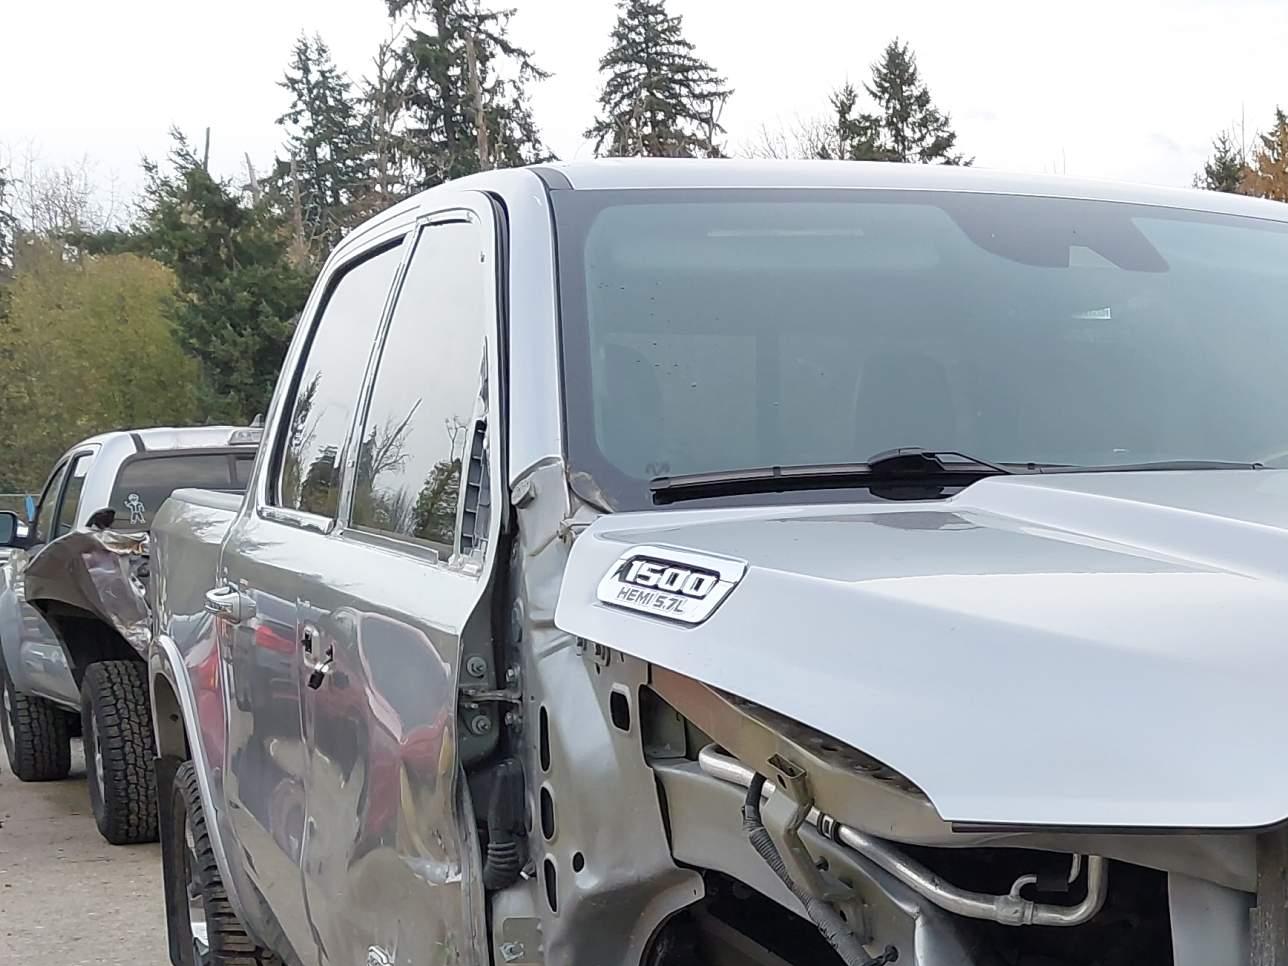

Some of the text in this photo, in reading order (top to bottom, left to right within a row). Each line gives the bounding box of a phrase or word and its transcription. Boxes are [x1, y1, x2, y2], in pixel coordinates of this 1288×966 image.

[624, 560, 718, 597] 1500
[616, 587, 684, 613] HEMI 5.7L
